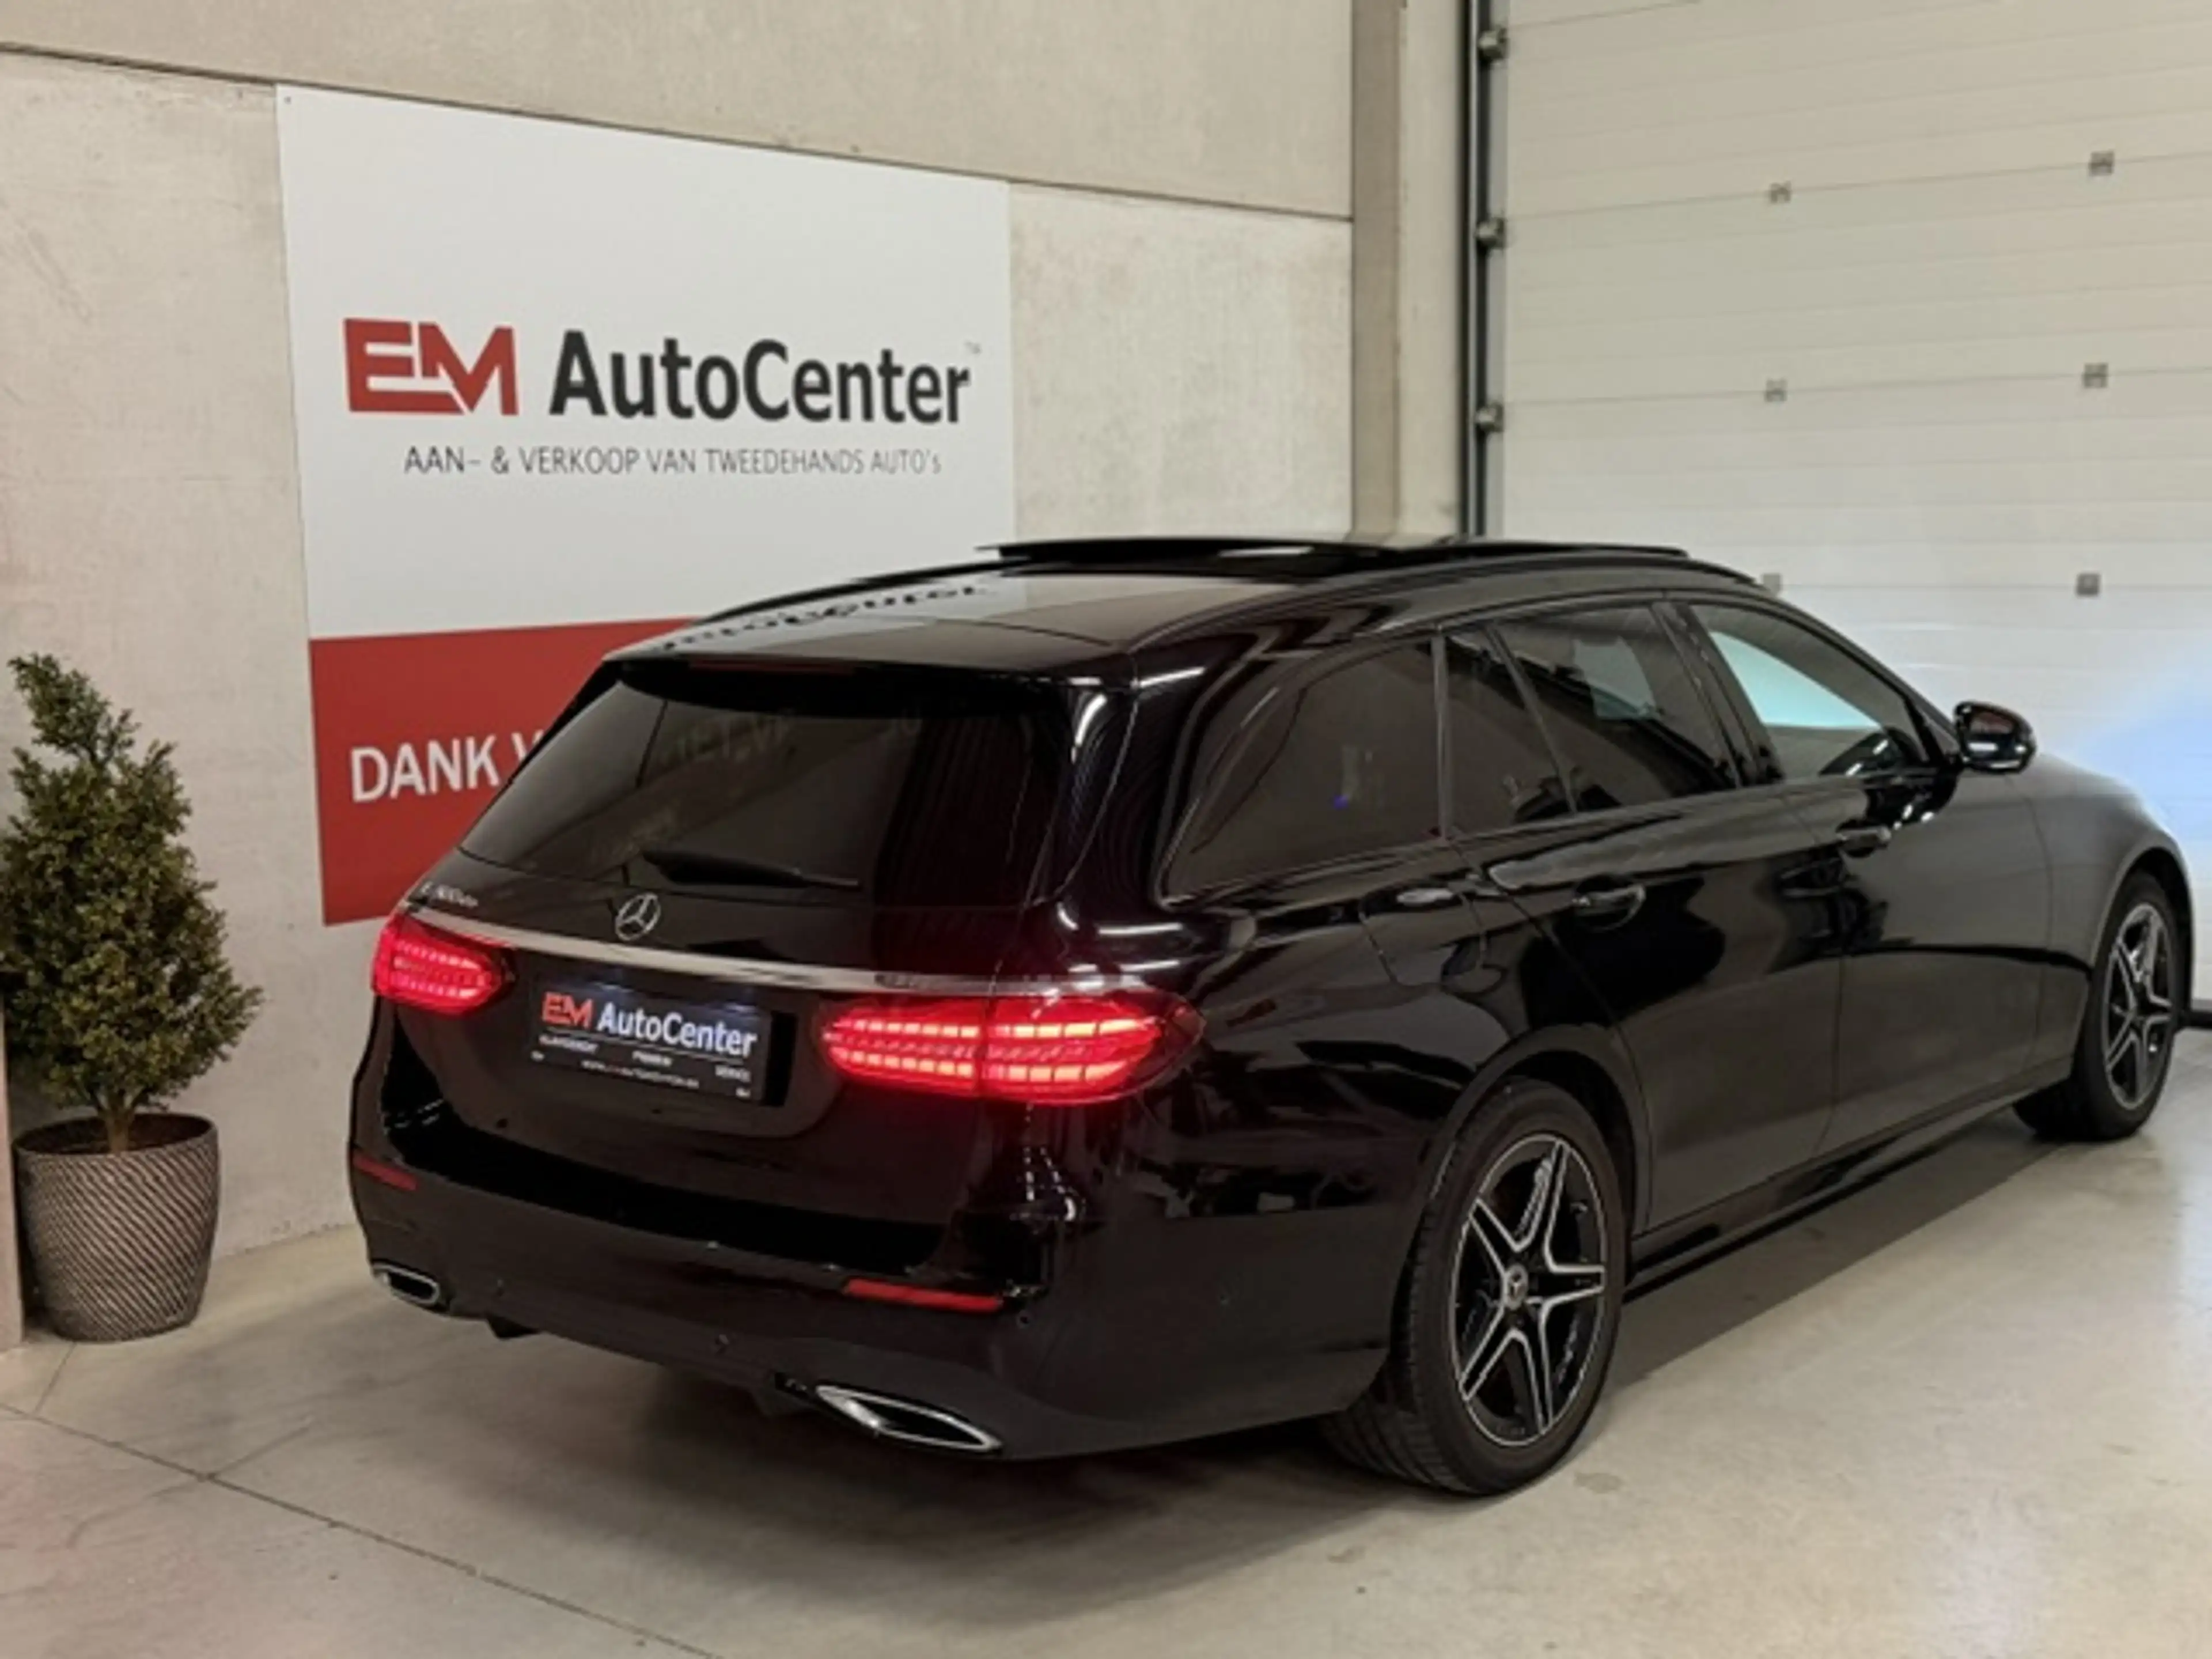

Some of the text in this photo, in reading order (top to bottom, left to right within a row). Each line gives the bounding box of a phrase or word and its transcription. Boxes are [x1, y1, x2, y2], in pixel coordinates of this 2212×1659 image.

[344, 318, 970, 424] EM AutoCenter
[404, 445, 942, 475] AAN- & VERKOOP VAN TWEEDEHANDS AUTO's
[351, 734, 499, 803] DANK
[541, 991, 757, 1058] EM AutoCenter
